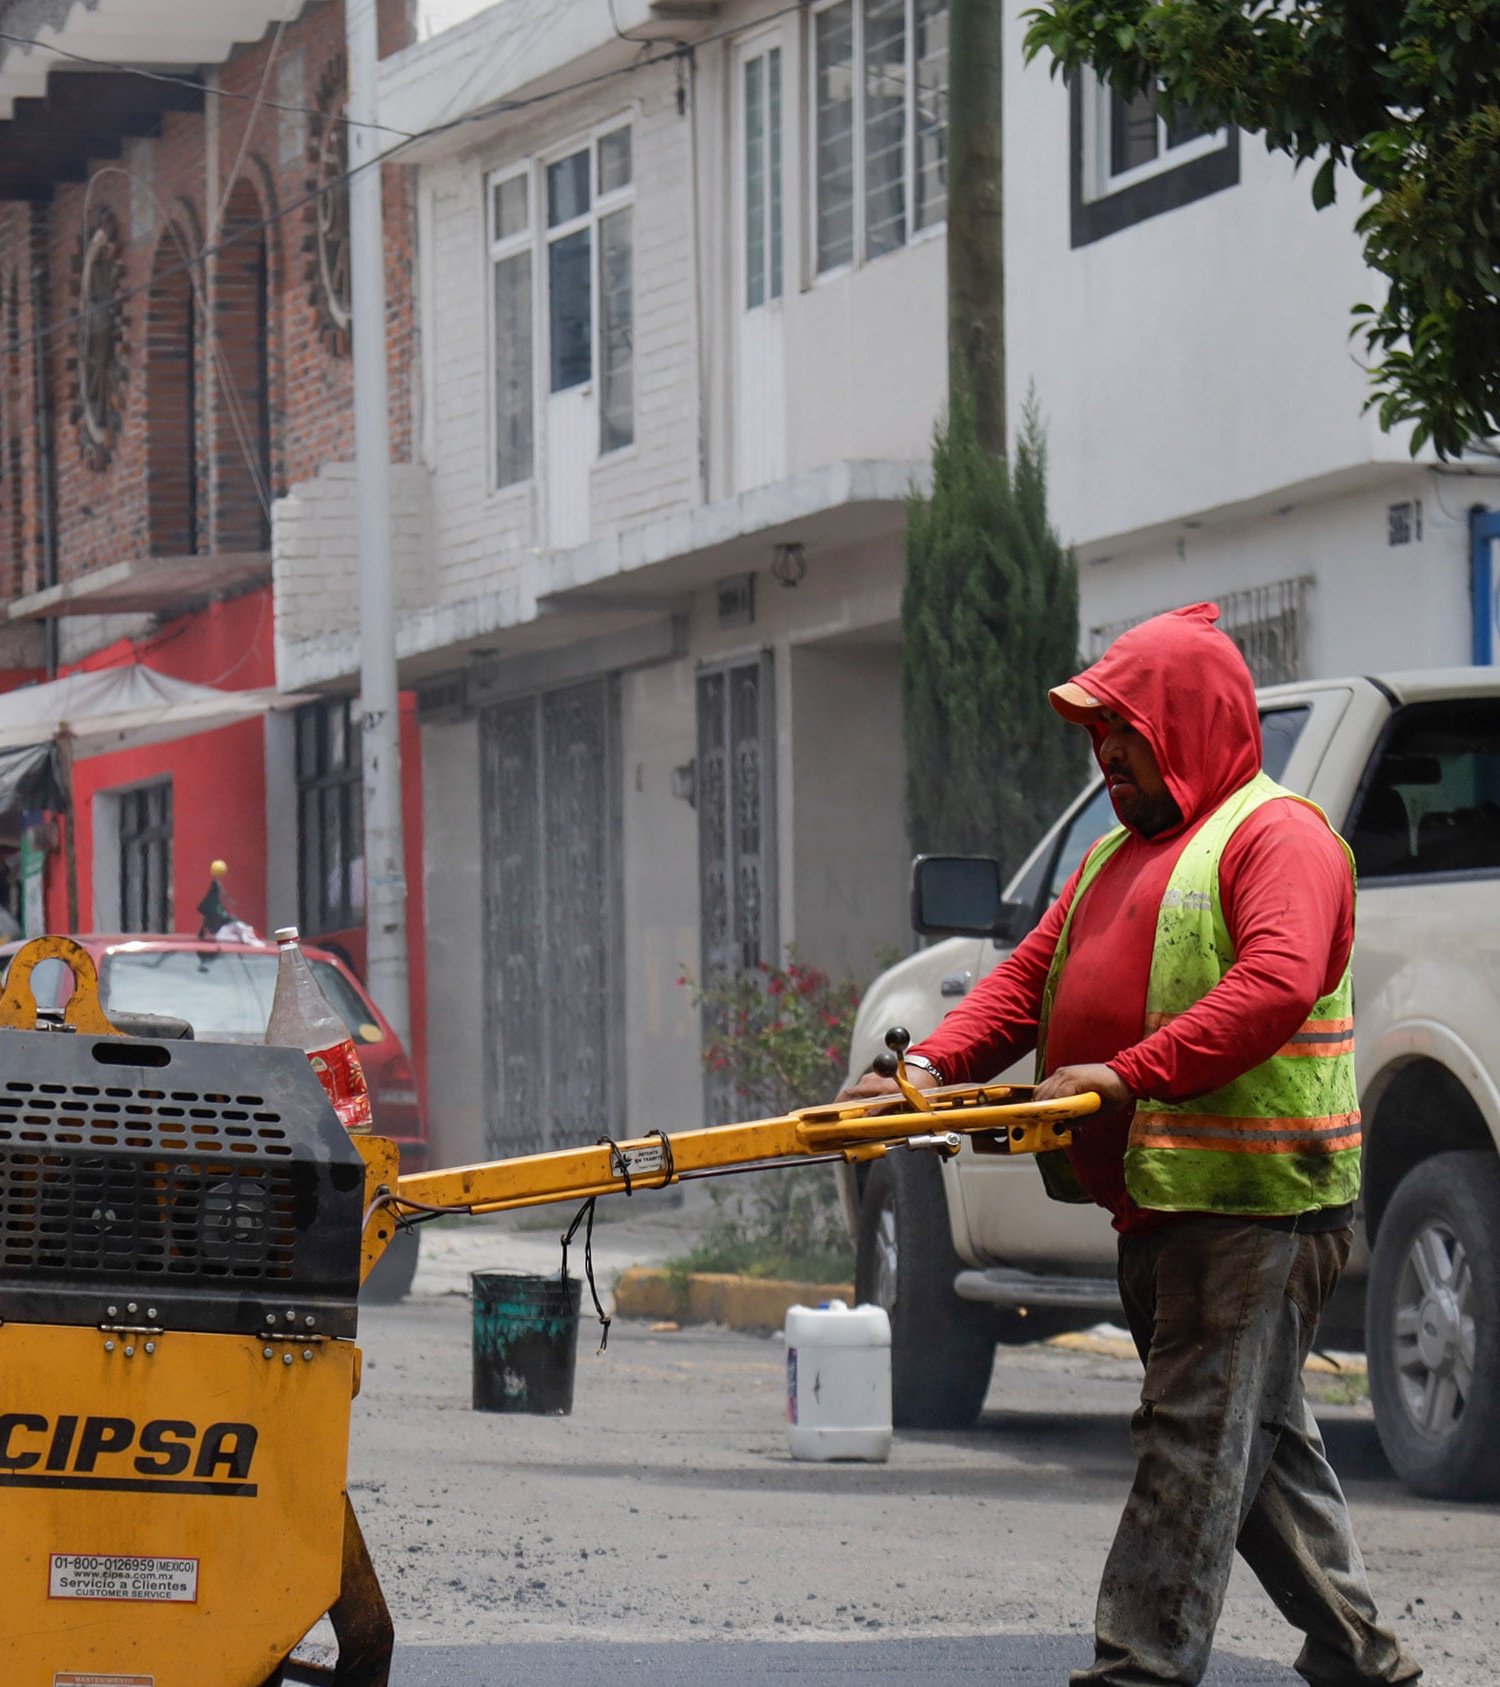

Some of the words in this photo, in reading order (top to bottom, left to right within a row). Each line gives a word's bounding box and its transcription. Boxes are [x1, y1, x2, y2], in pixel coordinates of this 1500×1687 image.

[54, 1557, 155, 1572] 01-800-0126959
[156, 1561, 194, 1573] (MEXICO)
[74, 1571, 173, 1580] www.cipsa.com.mx
[59, 1577, 116, 1589] Servicio
[120, 1581, 127, 1589] a
[132, 1580, 187, 1591] Clientes
[75, 1589, 129, 1598] CUSTOMER
[131, 1590, 172, 1599] SERVICE
